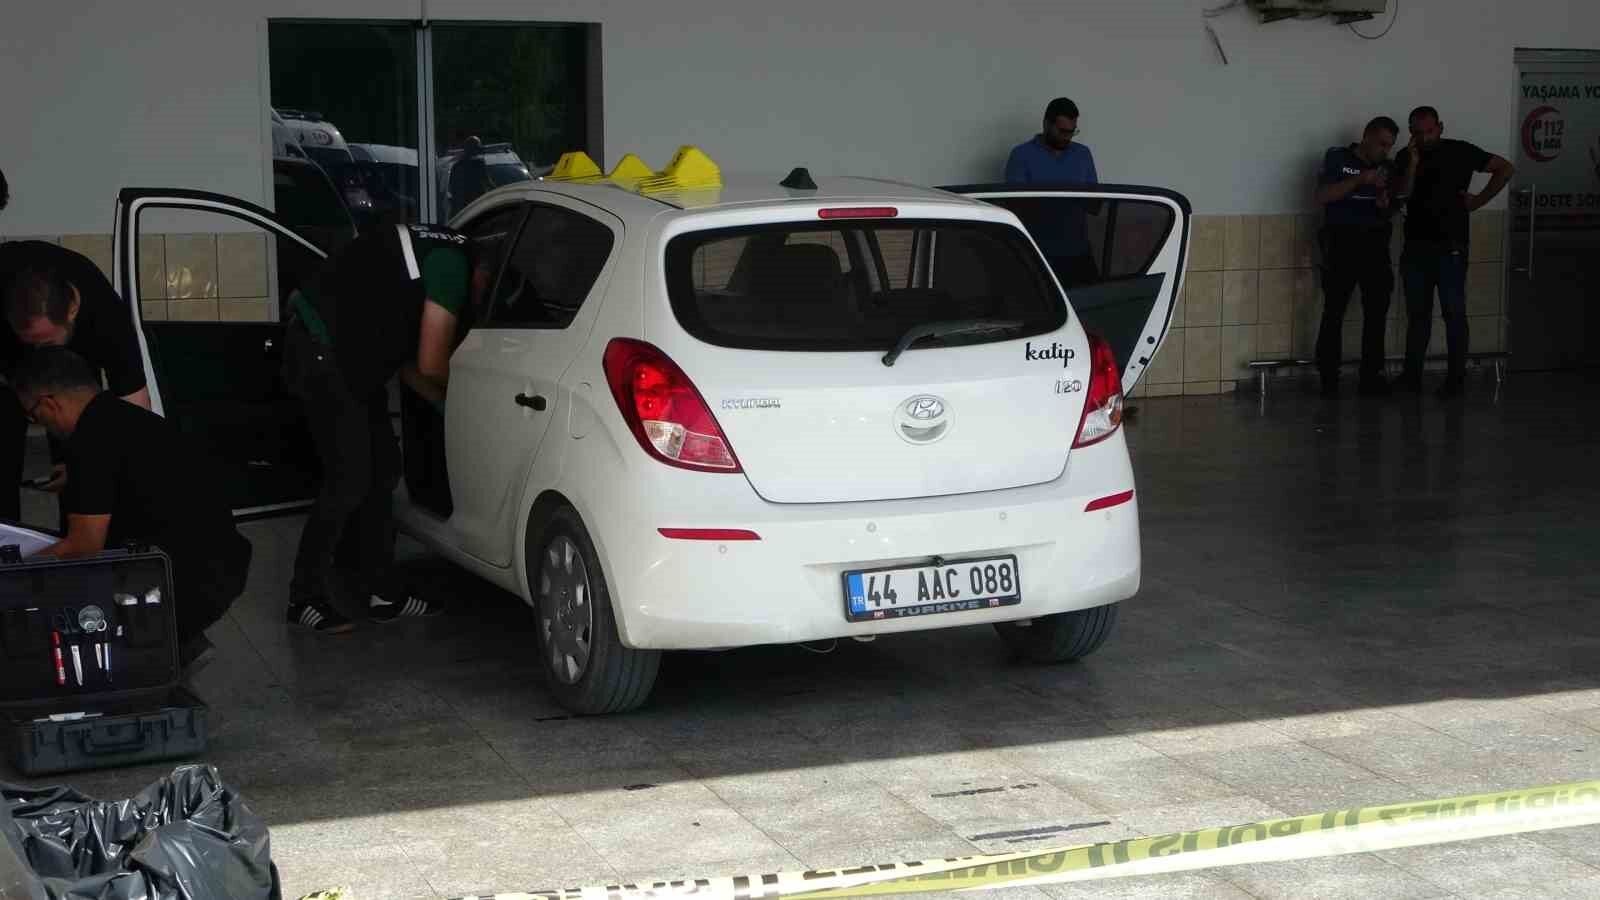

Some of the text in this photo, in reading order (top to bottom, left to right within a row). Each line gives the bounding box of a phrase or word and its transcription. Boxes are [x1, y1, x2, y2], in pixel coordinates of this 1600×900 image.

[1522, 85, 1580, 102] YAŞAMA
[1544, 119, 1563, 135] 112
[1025, 342, 1075, 368] katip
[852, 563, 1013, 607] TR 44 AAC 088
